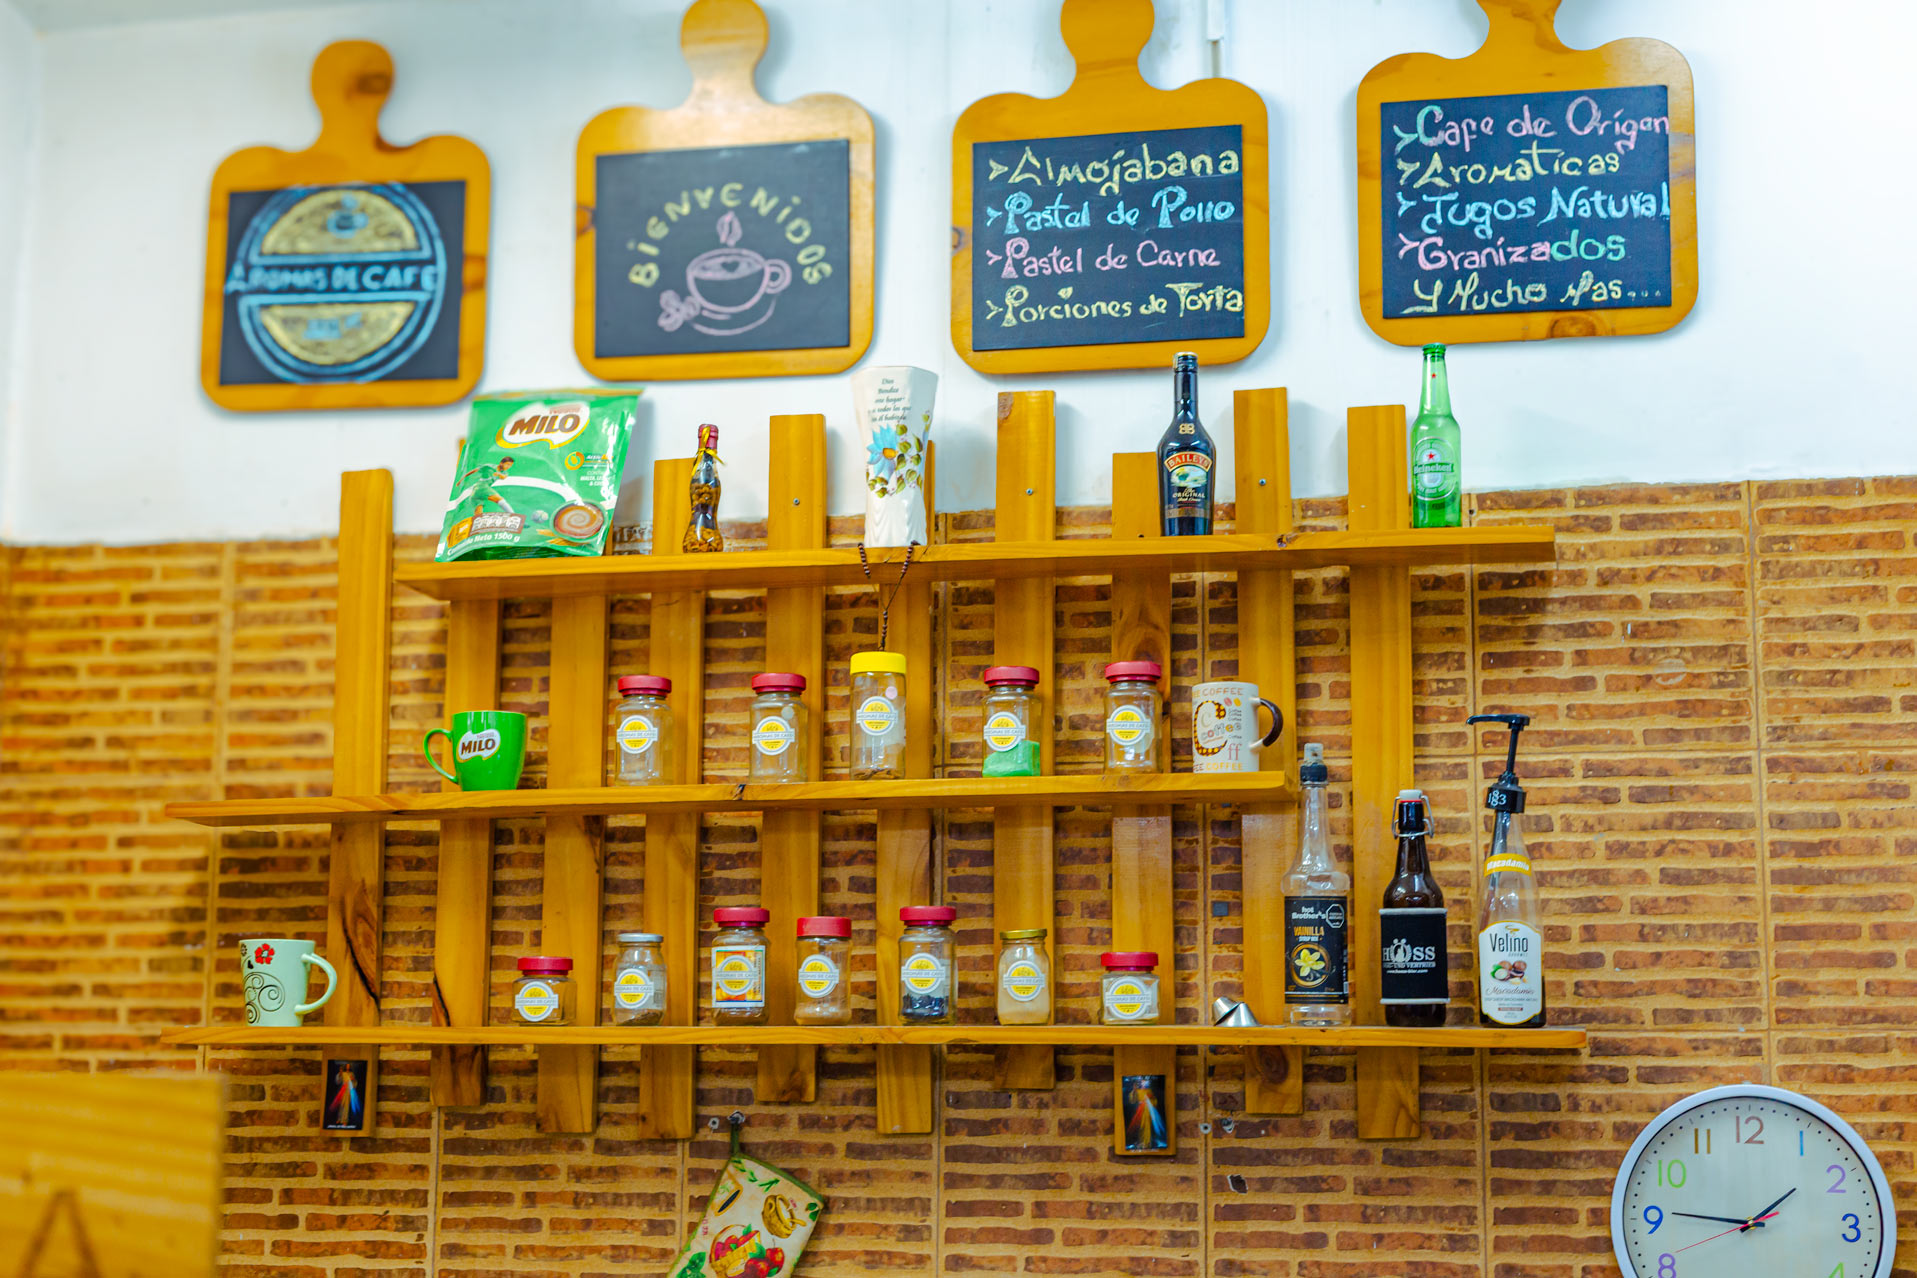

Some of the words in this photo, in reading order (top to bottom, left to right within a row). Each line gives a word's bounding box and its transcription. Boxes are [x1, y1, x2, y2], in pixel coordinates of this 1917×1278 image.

[1507, 104, 1557, 137] de
[1107, 200, 1140, 227] de
[1152, 185, 1235, 228] Pollo
[1537, 181, 1670, 227] Natural
[1001, 237, 1082, 279] Pastel
[1095, 243, 1128, 271] de
[1137, 240, 1221, 268] Carne
[1001, 284, 1132, 327] Porciones
[1139, 294, 1167, 315] de
[1165, 282, 1243, 318] Torta
[1448, 271, 1547, 311] Mucho
[508, 413, 582, 436] MILO
[1167, 454, 1209, 467] BAILEYS
[1202, 687, 1244, 696] COFFEE
[461, 738, 496, 755] MILO
[1489, 932, 1528, 952] Velino
[1694, 1128, 1711, 1154] 11
[1735, 1115, 1765, 1144] 12
[1799, 1130, 1804, 1156] 1
[1658, 1159, 1687, 1188] 10
[1826, 1164, 1847, 1193] 2
[1643, 1205, 1664, 1234] 9
[1841, 1213, 1861, 1242] 3
[1657, 1253, 1677, 1278] 8
